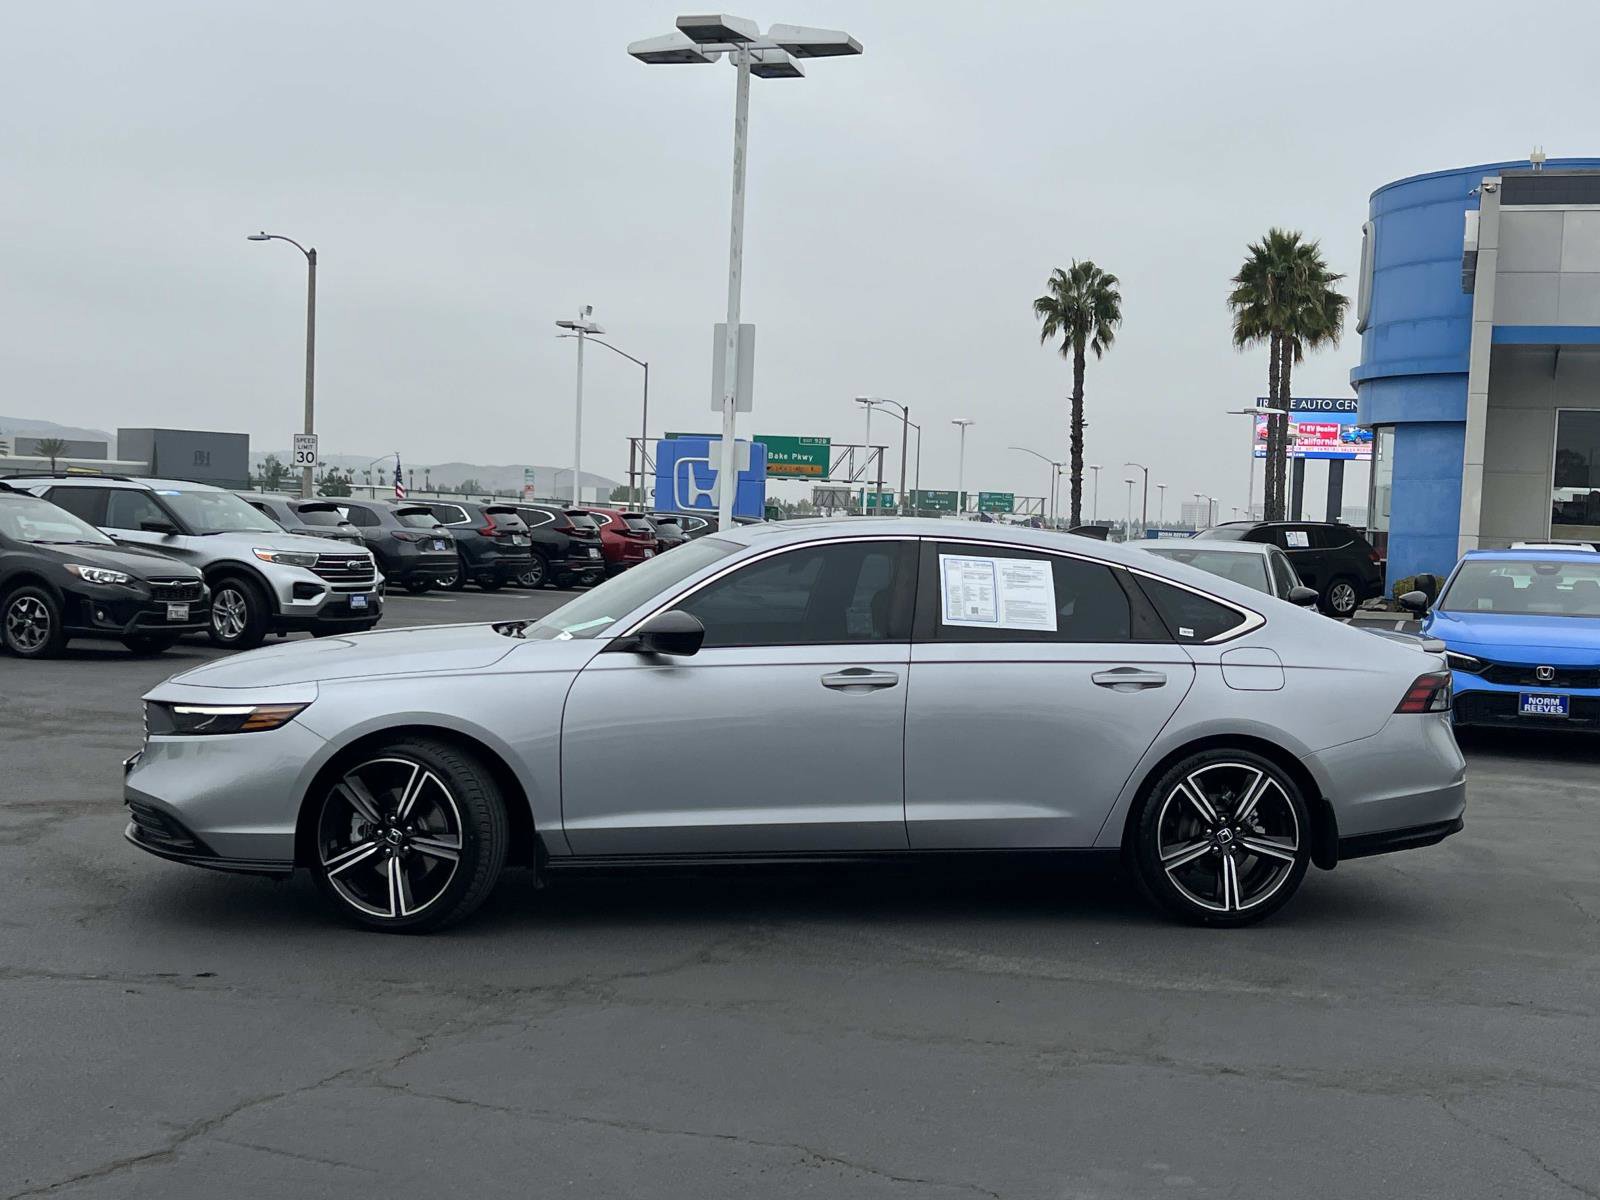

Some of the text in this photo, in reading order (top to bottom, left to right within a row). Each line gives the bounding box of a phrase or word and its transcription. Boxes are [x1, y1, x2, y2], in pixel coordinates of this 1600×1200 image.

[1299, 399, 1332, 410] AUTO
[1298, 437, 1337, 446] California
[296, 452, 314, 463] 30
[768, 452, 814, 462] Bake Pkwy
[1528, 697, 1560, 705] NORM
[1524, 704, 1564, 713] REEVES
